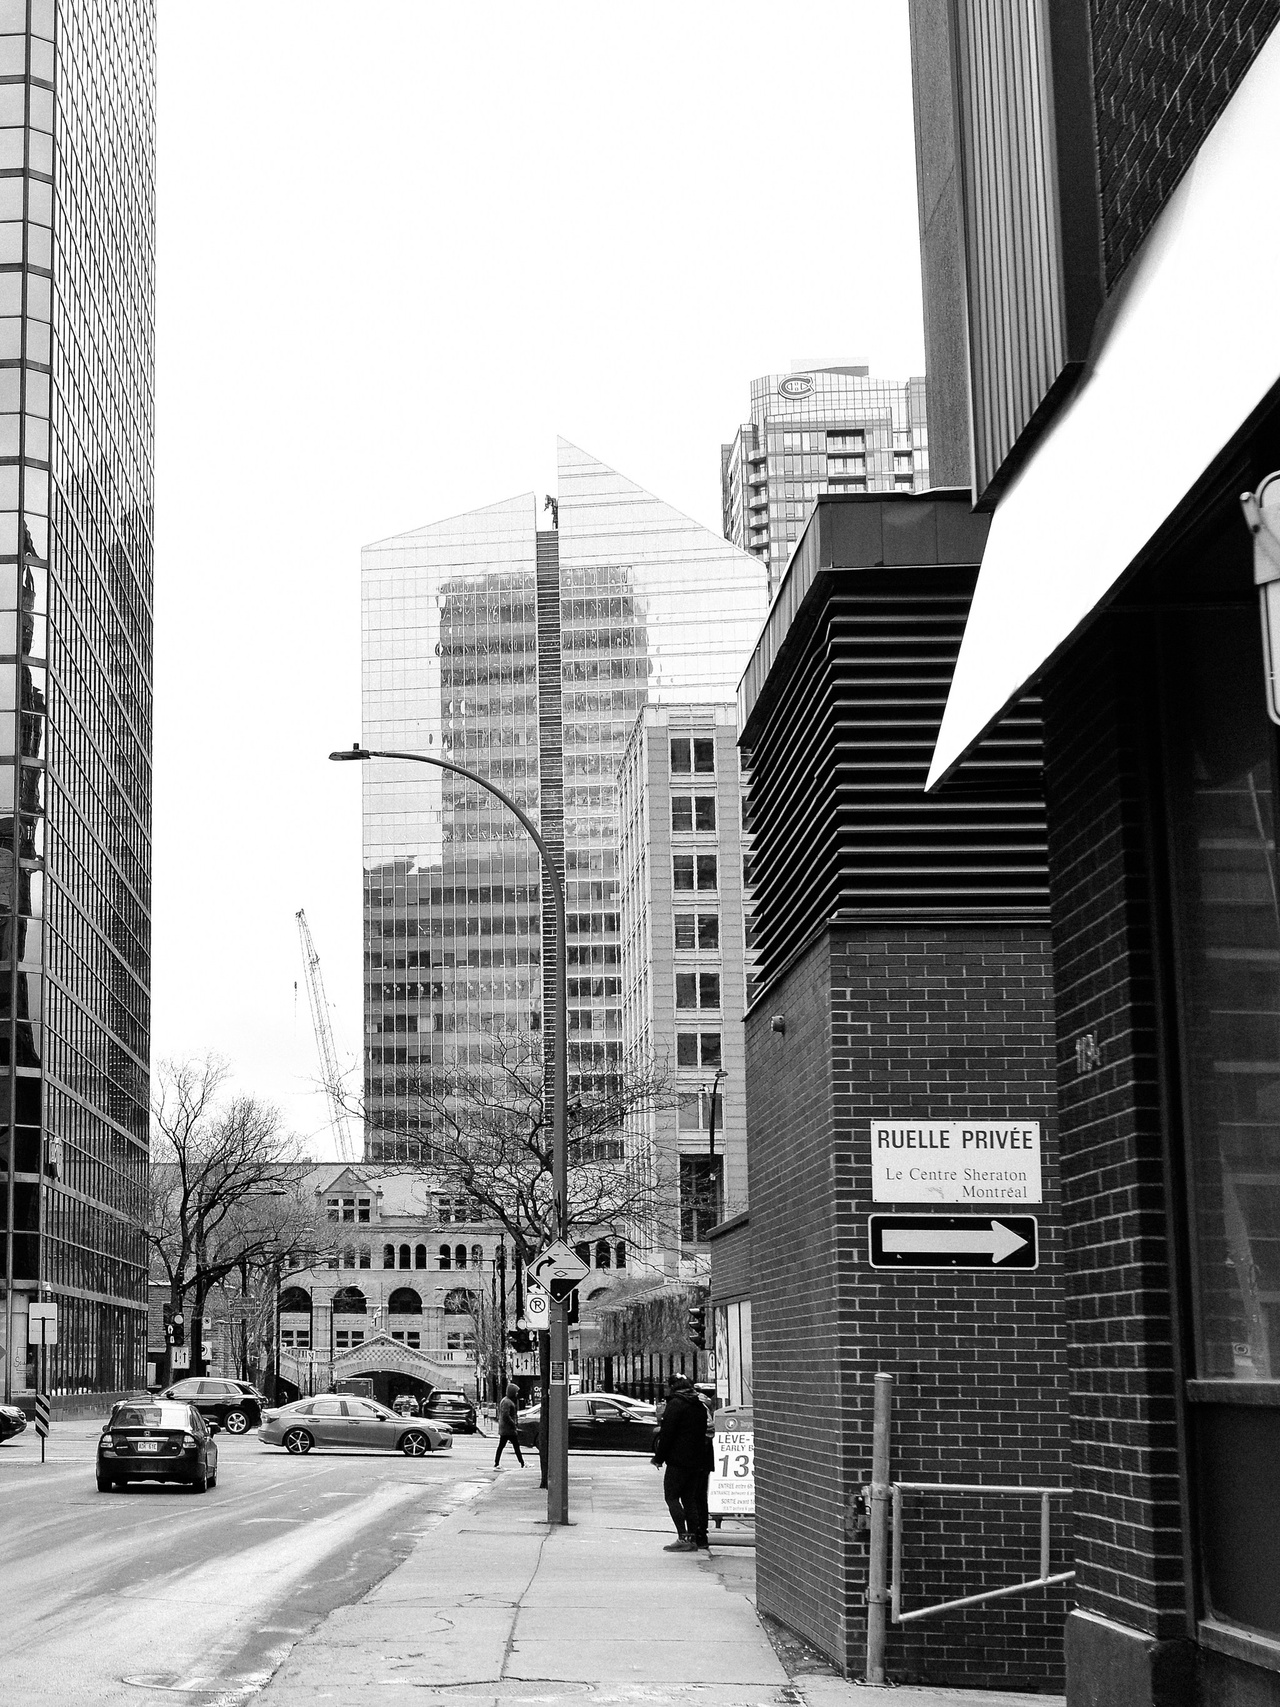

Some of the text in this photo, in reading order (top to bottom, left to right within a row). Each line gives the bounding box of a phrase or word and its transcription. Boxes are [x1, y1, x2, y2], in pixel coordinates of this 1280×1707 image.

[877, 1126, 1034, 1150] RUELLE PRIVÉE
[885, 1167, 1027, 1182] Le Centre Sheraton
[962, 1185, 1028, 1199] Montréal
[721, 1444, 746, 1452] EARLY
